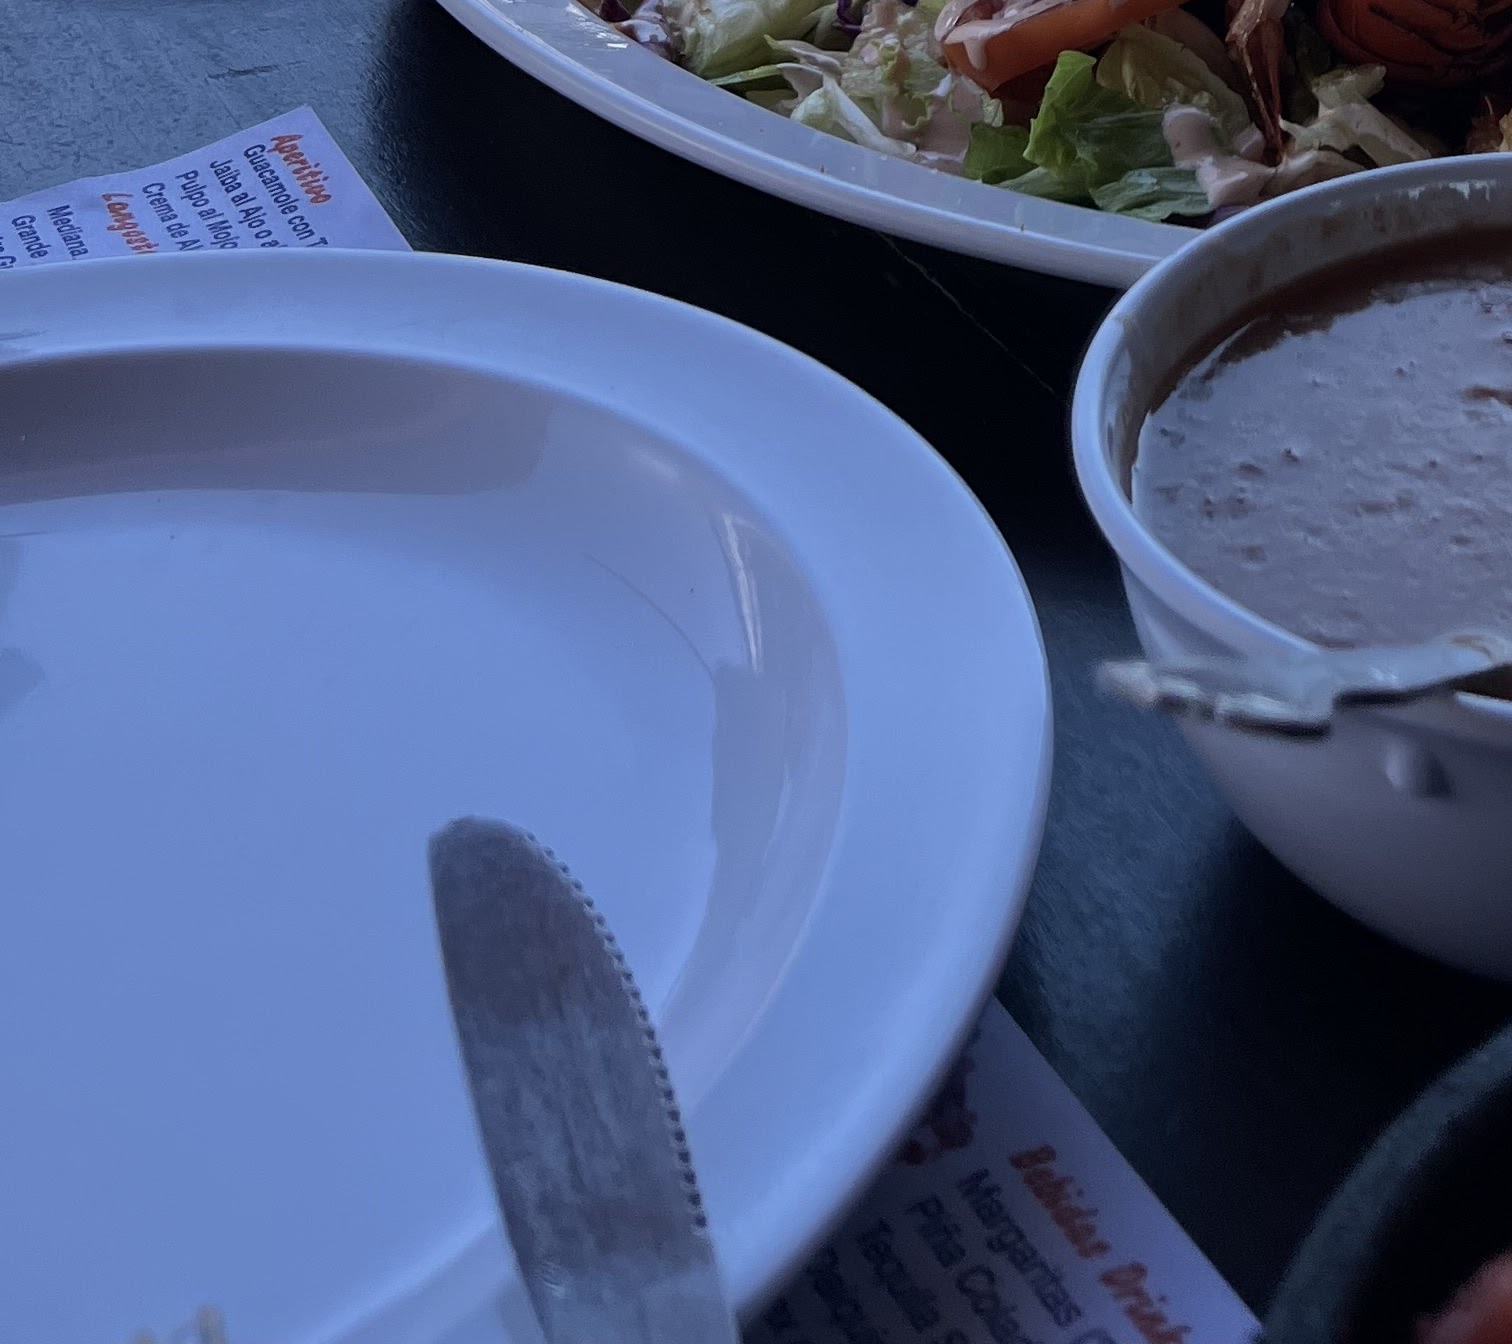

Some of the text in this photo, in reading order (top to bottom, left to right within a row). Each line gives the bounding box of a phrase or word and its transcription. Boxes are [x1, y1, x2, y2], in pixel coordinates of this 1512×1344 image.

[210, 159, 242, 194] Jaiba
[243, 144, 315, 241] Guacamole con
[267, 134, 332, 204] Aperitivo
[101, 193, 160, 254] Langost
[142, 182, 179, 223] Crema
[166, 222, 191, 239] de
[175, 169, 240, 249] Pulpo al Mojo
[230, 192, 257, 208] al
[238, 206, 267, 229] Ajo
[11, 214, 52, 259] Grande
[254, 229, 273, 239] o
[957, 1168, 1083, 1328] Margaritas
